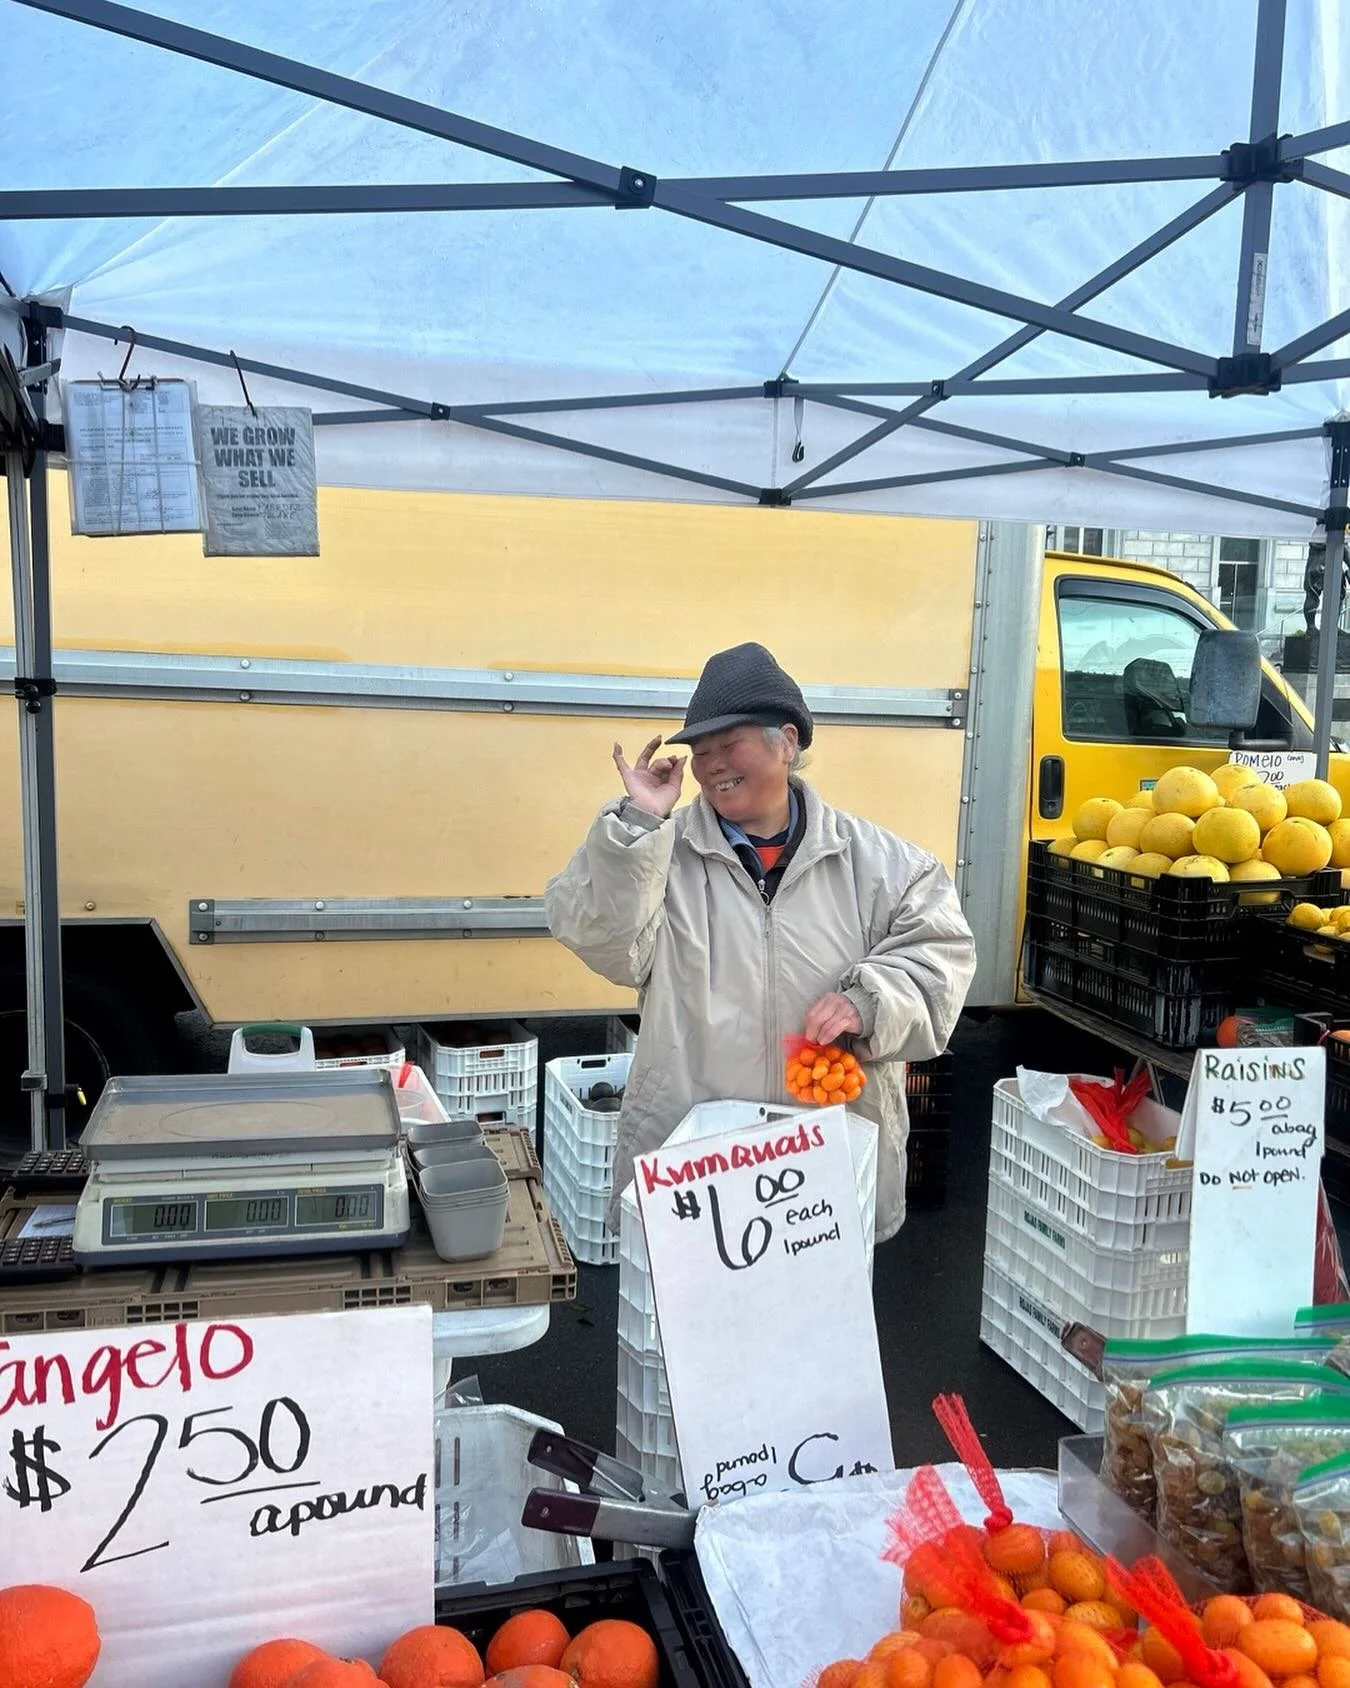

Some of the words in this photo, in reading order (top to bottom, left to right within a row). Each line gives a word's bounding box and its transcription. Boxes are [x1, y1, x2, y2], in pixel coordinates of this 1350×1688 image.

[210, 427, 239, 445] WE
[242, 426, 295, 445] GROW
[214, 448, 264, 467] WHAT
[267, 448, 295, 467] WE
[238, 470, 276, 487] SELL
[786, 1199, 833, 1225] each
[0, 1322, 254, 1431] angelo
